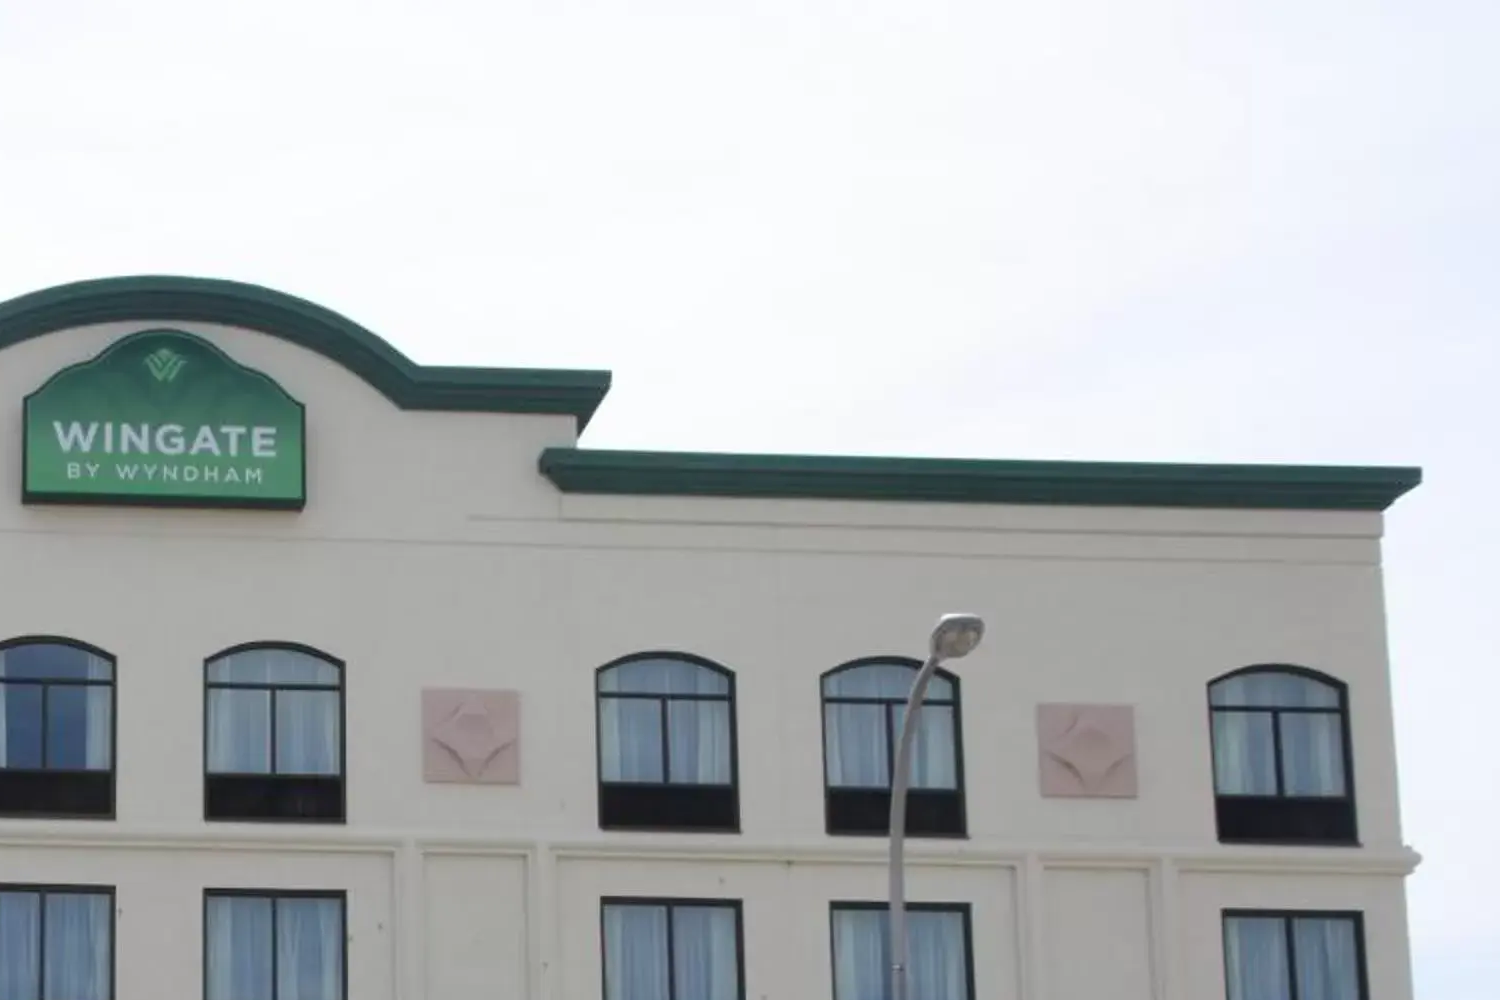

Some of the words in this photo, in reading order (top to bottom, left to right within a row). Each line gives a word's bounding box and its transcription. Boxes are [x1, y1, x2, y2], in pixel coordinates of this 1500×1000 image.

[53, 421, 277, 457] WINGATE
[67, 462, 100, 479] BY
[116, 464, 263, 484] WYNDHAM
